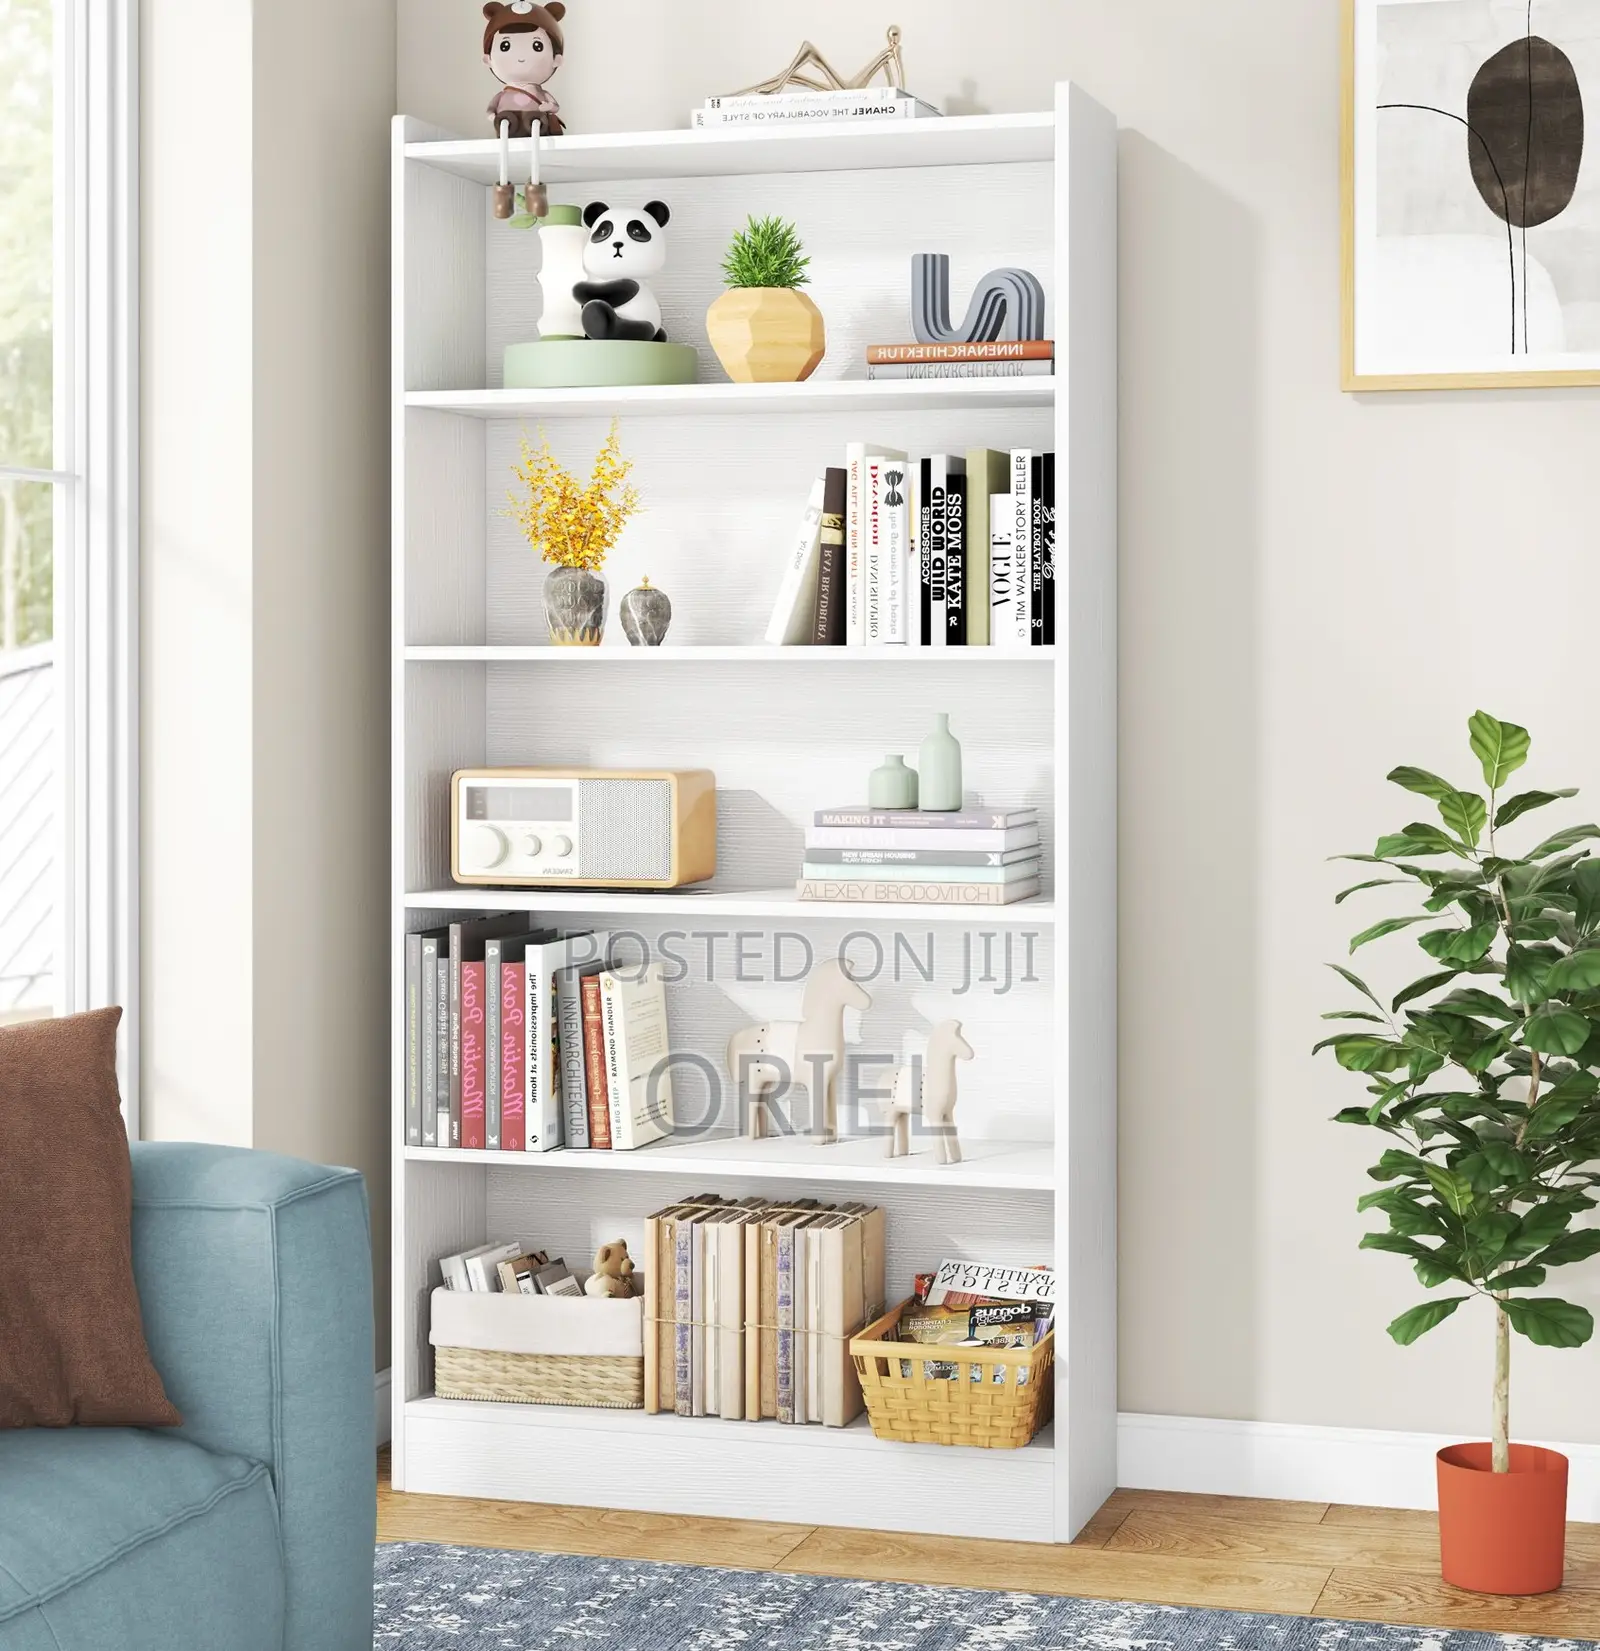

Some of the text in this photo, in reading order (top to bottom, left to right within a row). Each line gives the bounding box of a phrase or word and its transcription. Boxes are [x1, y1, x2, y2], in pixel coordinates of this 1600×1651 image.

[921, 506, 930, 585] ACCESSORIES
[932, 486, 946, 602] WILD WORLD
[948, 493, 962, 610] KATE MOSS
[992, 533, 1011, 607] VOGUE
[1016, 455, 1026, 622] TIM WALKER STORY TELLER
[1033, 498, 1041, 591] THE PLAYBOY BOOK
[1032, 619, 1042, 628] 50
[822, 814, 871, 825] MAKING
[873, 815, 887, 825] IT
[842, 851, 858, 859] NEW
[884, 852, 916, 860] HOUSING
[801, 883, 870, 900] ALEXEY
[874, 884, 989, 902] BRODOVITCH
[562, 996, 585, 1137] INNENARCHITEKTUR
[606, 996, 618, 1077] RAYMOND CHANDLER
